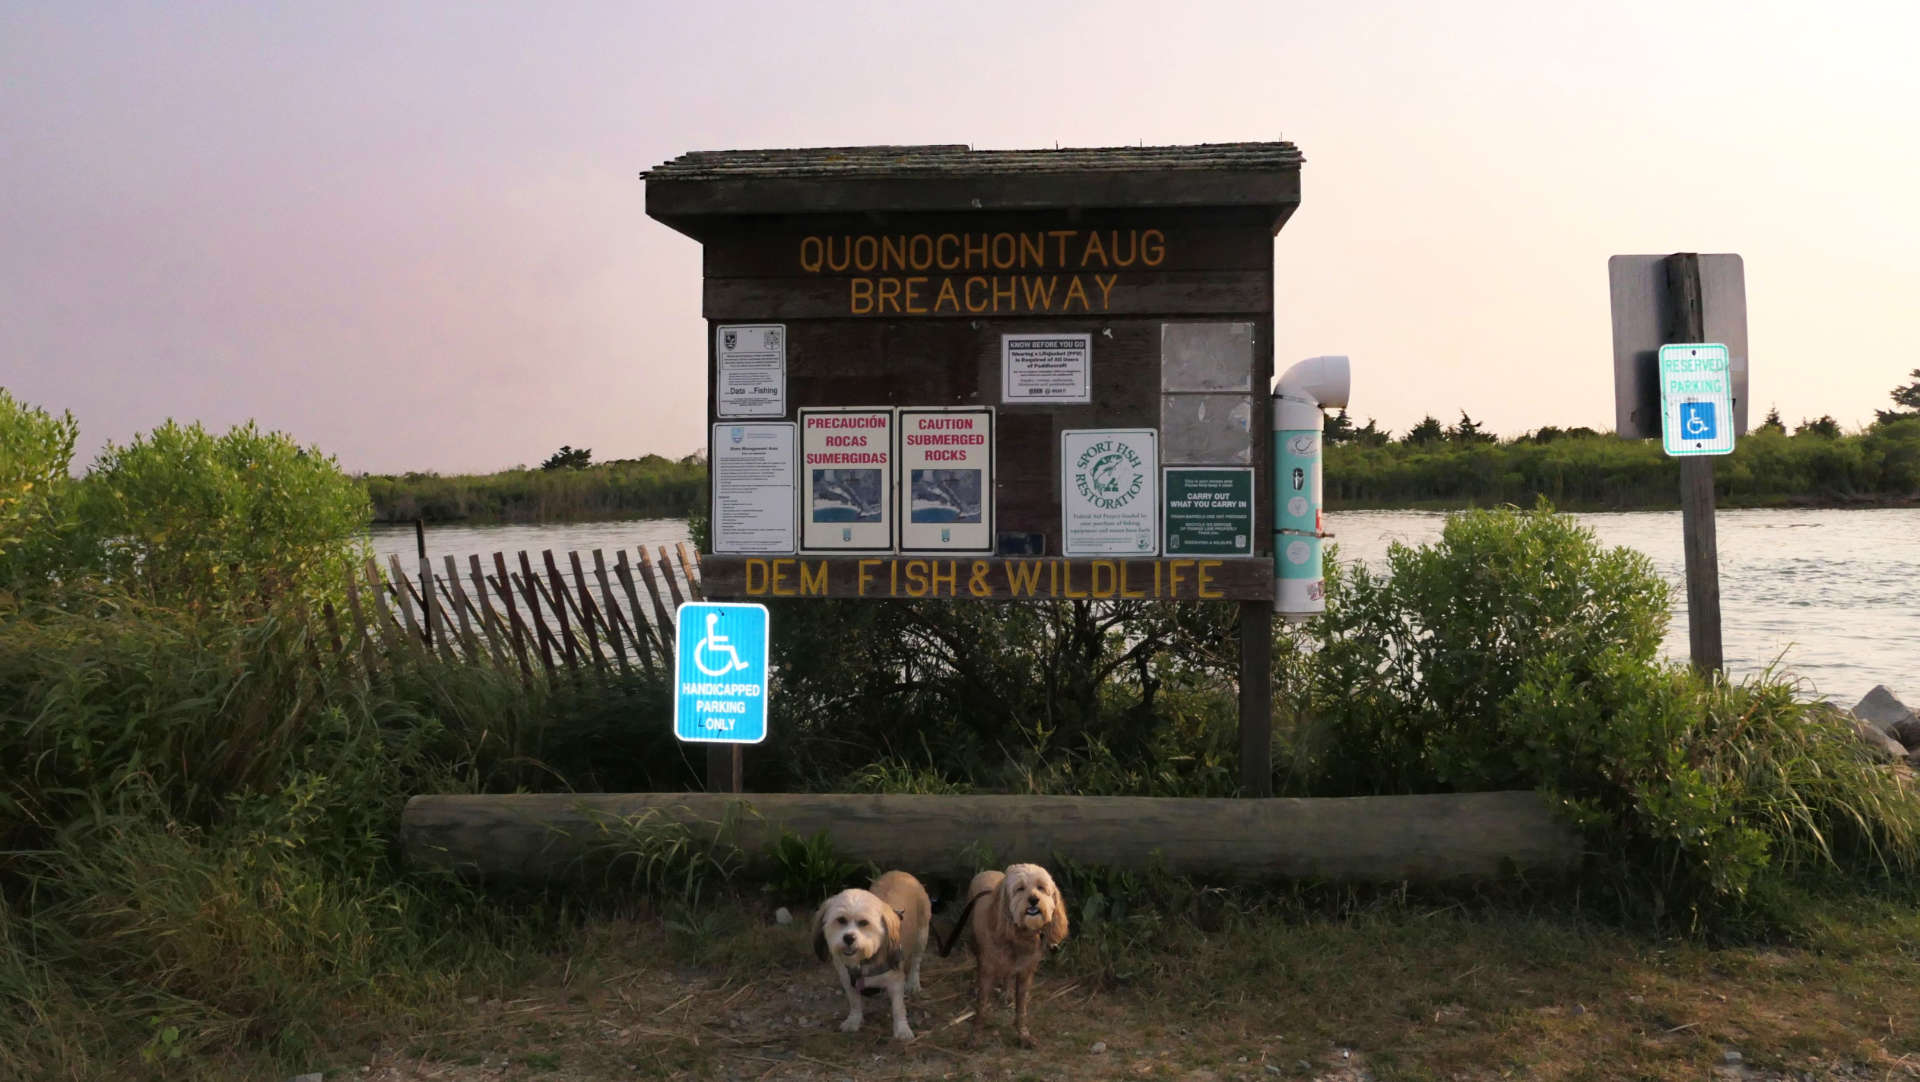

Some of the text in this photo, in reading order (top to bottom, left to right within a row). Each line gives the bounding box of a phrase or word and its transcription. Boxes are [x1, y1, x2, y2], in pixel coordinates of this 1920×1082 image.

[799, 229, 1167, 272] QUONOCHONTAUG
[850, 273, 1119, 315] BREACHWAY
[1666, 358, 1725, 373] RESERVED
[753, 386, 778, 396] Fishing
[1671, 379, 1722, 393] PARKING
[807, 415, 886, 429] PRECAUCIÓN
[918, 418, 973, 430] CAUTION
[825, 436, 867, 447] ROCAS
[907, 434, 985, 446] SUBMERGED
[806, 453, 887, 464] SUMERGIDAS
[924, 450, 967, 461] ROCKS
[1077, 441, 1142, 469] SPORT FISH
[1075, 473, 1144, 510] RESTORATION
[1187, 492, 1231, 500] CARRY OUT
[745, 558, 1226, 598] DEM FISH & WILDLIFE
[682, 682, 760, 696] HANDICAPPED
[696, 700, 746, 713] PARKING
[705, 717, 736, 730] ONLY
